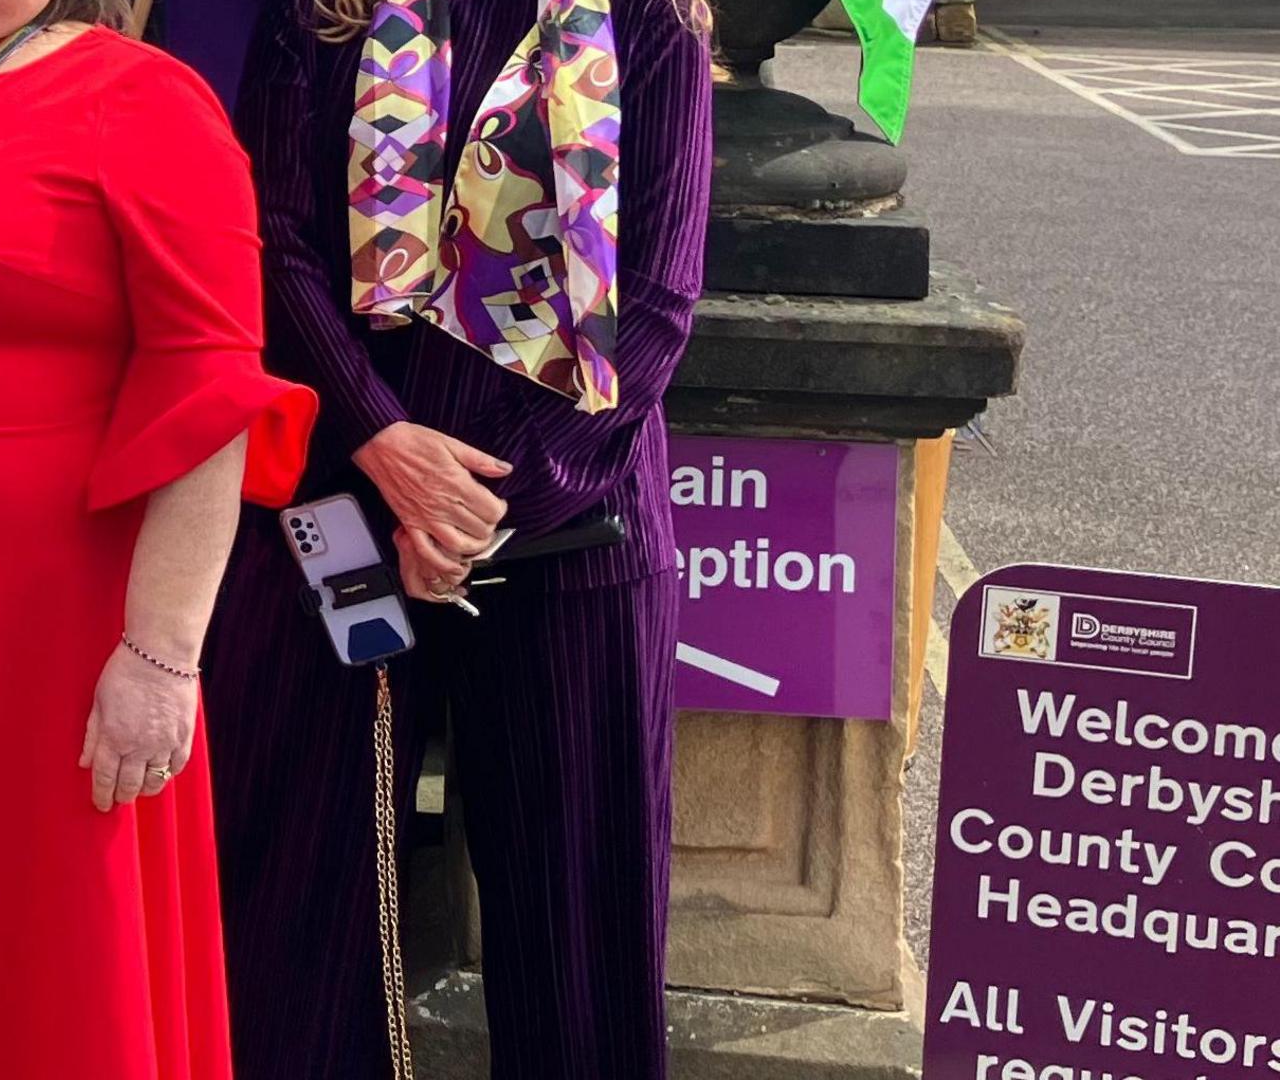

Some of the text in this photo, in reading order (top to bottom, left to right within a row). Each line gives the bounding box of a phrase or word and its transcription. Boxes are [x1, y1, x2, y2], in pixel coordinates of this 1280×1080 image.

[670, 455, 767, 508] ain
[1100, 632, 1137, 646] County
[1101, 623, 1177, 640] DERBYSHIRE
[1016, 689, 1280, 762] Welcom
[1032, 751, 1280, 825] Derbysh
[950, 808, 1177, 885] County
[977, 875, 1280, 957] Headquar
[939, 981, 1024, 1035] All
